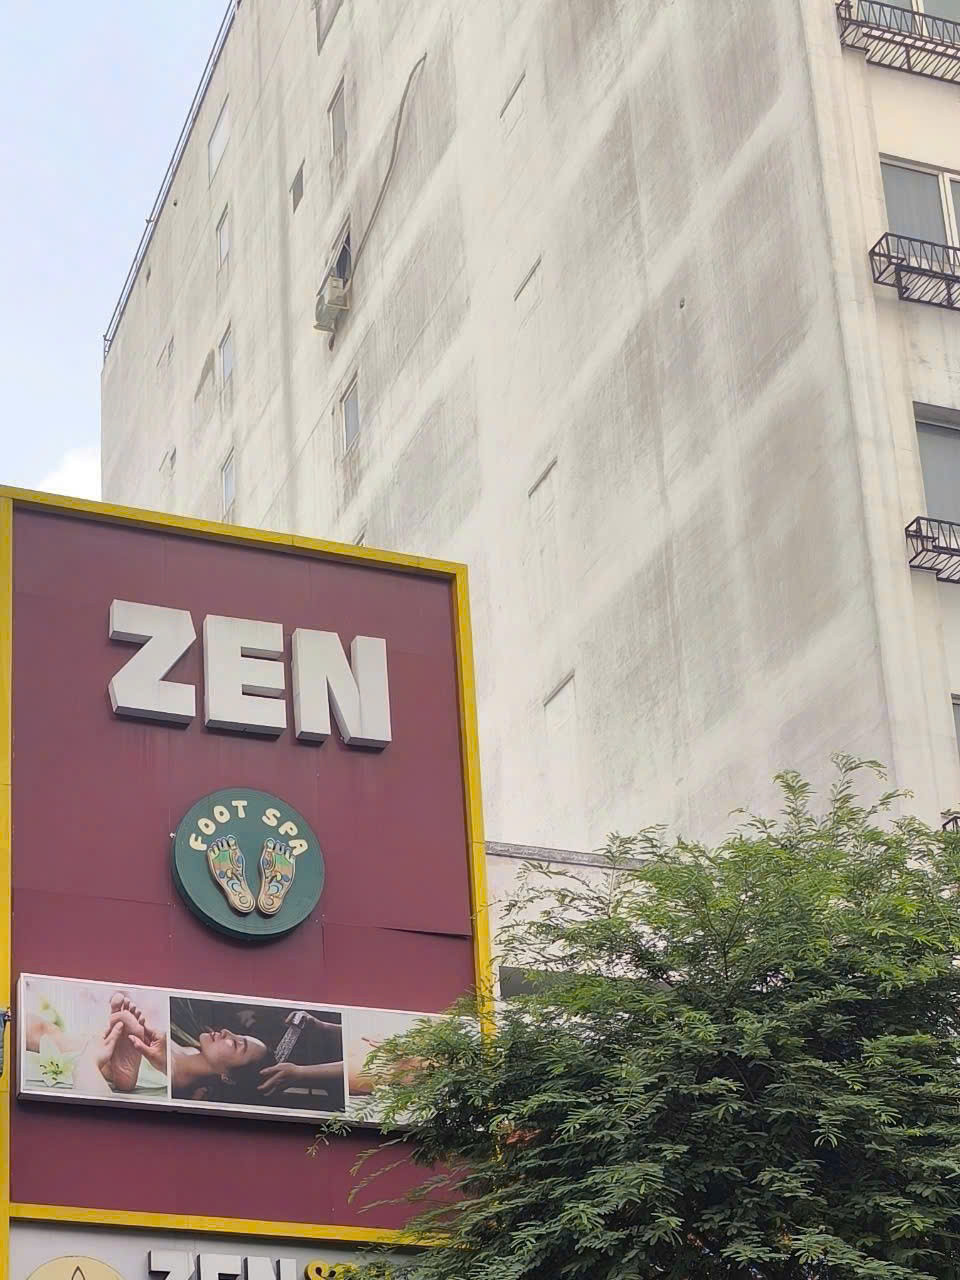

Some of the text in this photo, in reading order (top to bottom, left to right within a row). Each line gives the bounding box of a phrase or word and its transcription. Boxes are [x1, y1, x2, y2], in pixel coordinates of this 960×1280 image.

[109, 598, 392, 749] ZEN
[189, 799, 308, 857] FOOT SPA
